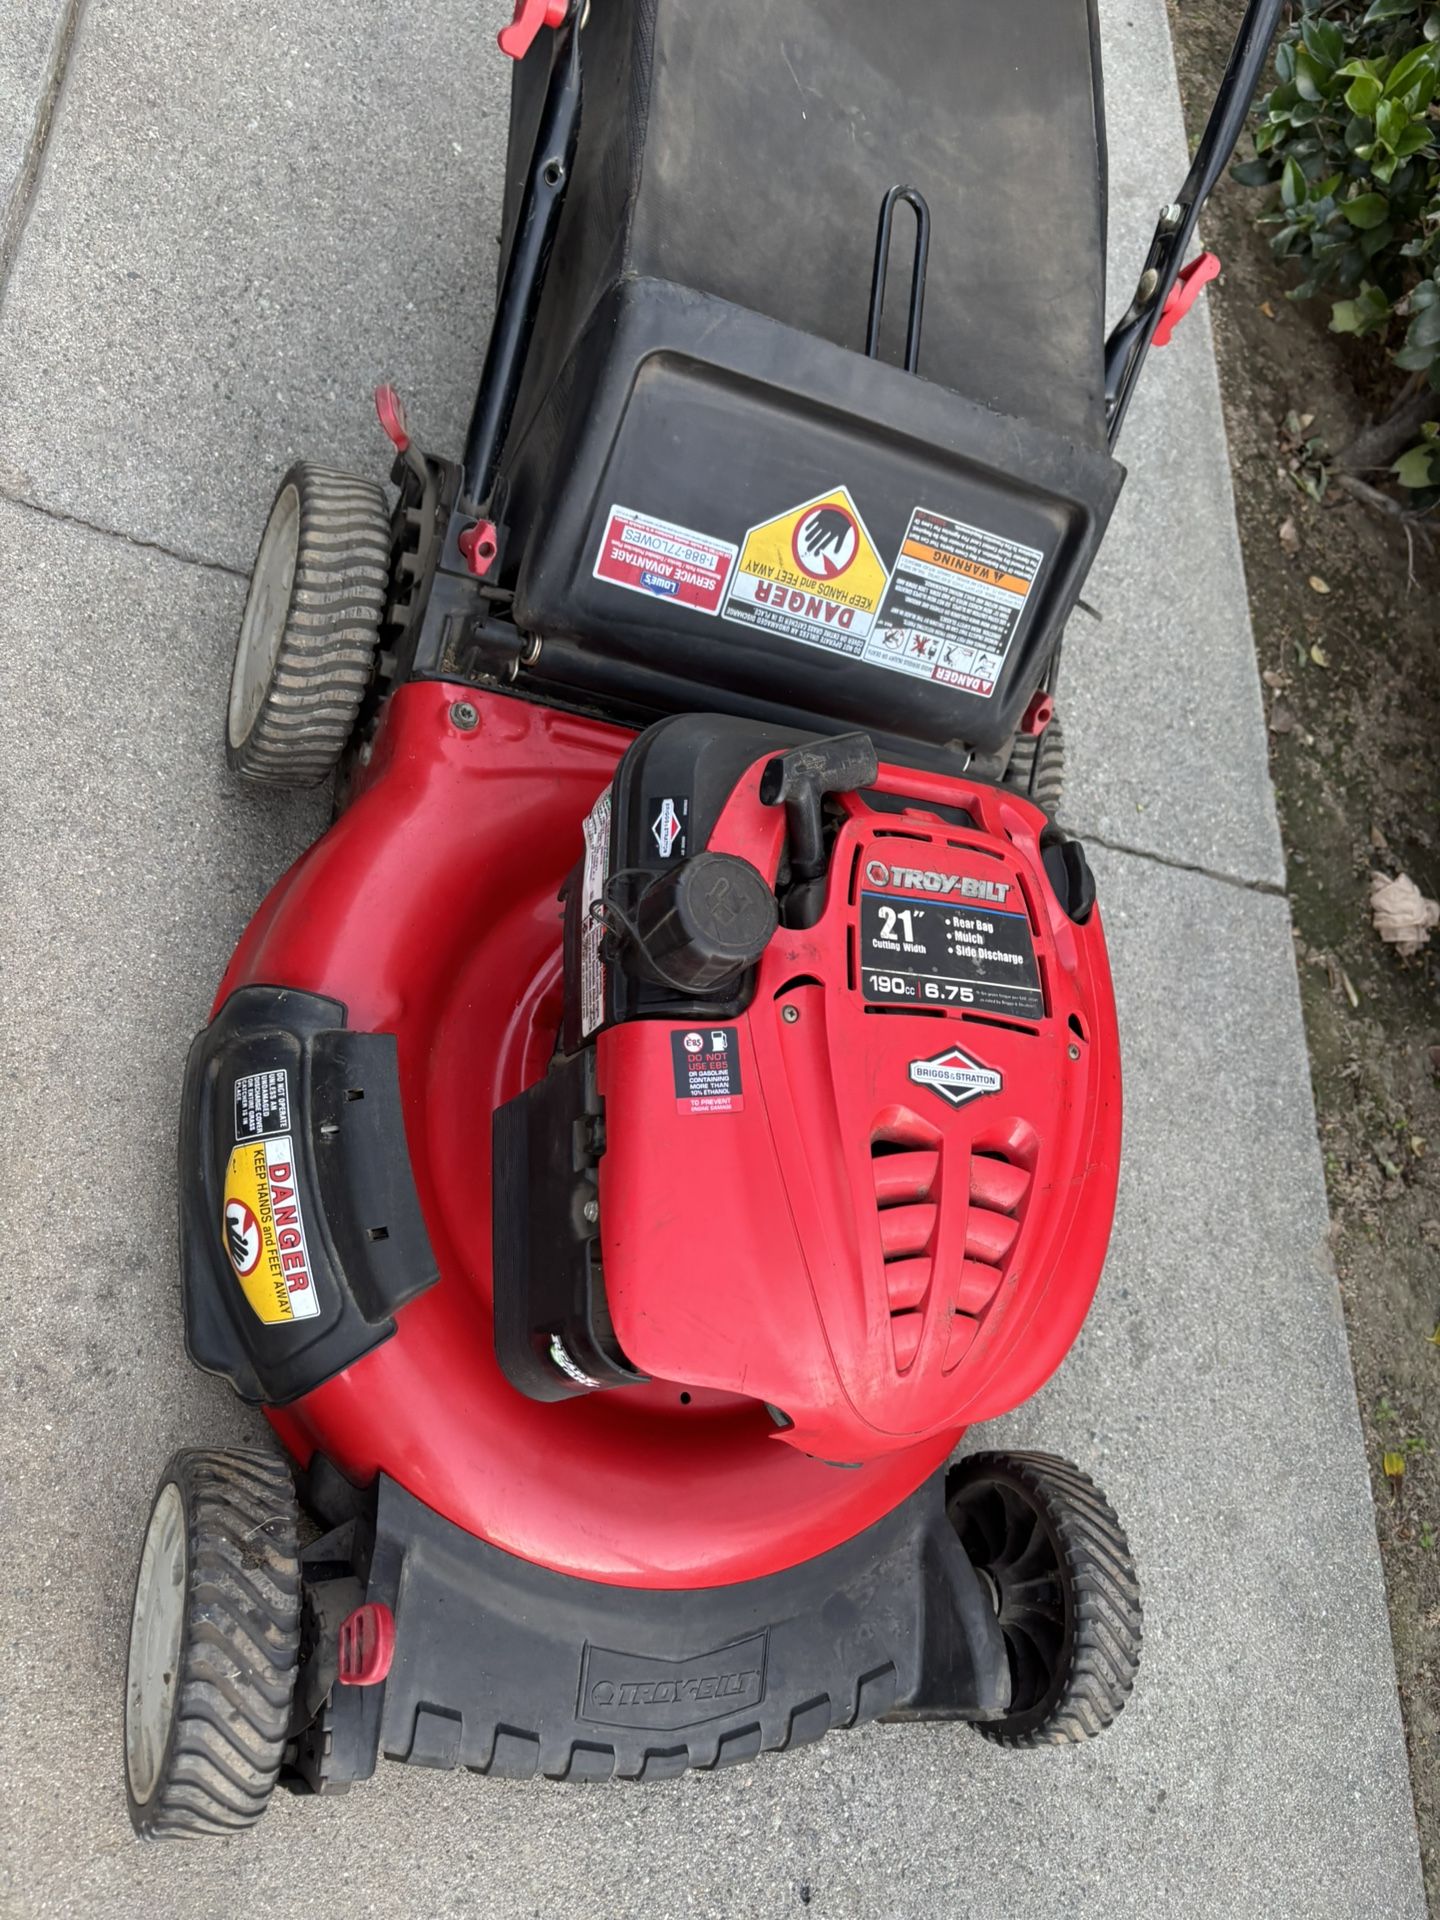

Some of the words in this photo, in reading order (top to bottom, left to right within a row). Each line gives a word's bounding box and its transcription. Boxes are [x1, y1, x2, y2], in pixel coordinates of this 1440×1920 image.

[610, 547, 673, 576] ADVANTAGE
[744, 558, 775, 577] AWAY
[931, 550, 991, 579] WARNING
[673, 567, 716, 590] SERVICE
[774, 568, 799, 585] FEET
[798, 576, 817, 591] and
[816, 582, 849, 602] HANDS
[847, 592, 873, 610] KEEP
[752, 579, 856, 629] DANGER
[726, 607, 756, 622] DISCHARGE
[756, 616, 790, 632] UNDAMAGED
[790, 626, 798, 635] AN
[798, 629, 820, 641] UNLESS
[819, 635, 843, 648] OPERATE
[842, 642, 853, 652] NOT
[853, 646, 861, 654] DO
[934, 667, 981, 689] DANGER
[890, 866, 1010, 903] TROY-BILT
[952, 916, 975, 931] Rear
[976, 920, 994, 934] Bag
[872, 938, 900, 952] Cutting
[903, 943, 926, 954] Width
[954, 931, 984, 945] Mulch
[955, 945, 978, 959] Side
[979, 947, 1024, 965] Discharge
[869, 975, 915, 996] 190cc
[924, 985, 975, 1003] 6.75
[687, 1054, 702, 1062] DO
[706, 1052, 727, 1060] NOT
[688, 1062, 706, 1070] USE
[268, 1073, 276, 1099] UNLESS
[276, 1071, 283, 1082] DO
[689, 1075, 729, 1083] CONTAINING
[260, 1075, 269, 1117] UNDAMAGED
[270, 1100, 277, 1110] AN
[700, 1097, 731, 1105] PREVENT
[278, 1097, 287, 1127] OPERATE
[252, 1148, 266, 1180] KEEP
[257, 1182, 272, 1223] HANDS
[263, 1225, 275, 1246] and
[266, 1161, 310, 1293] DANGER
[267, 1248, 282, 1278] FEET
[273, 1280, 290, 1315] AWAY
[618, 1670, 757, 1706] TROY-BILT
